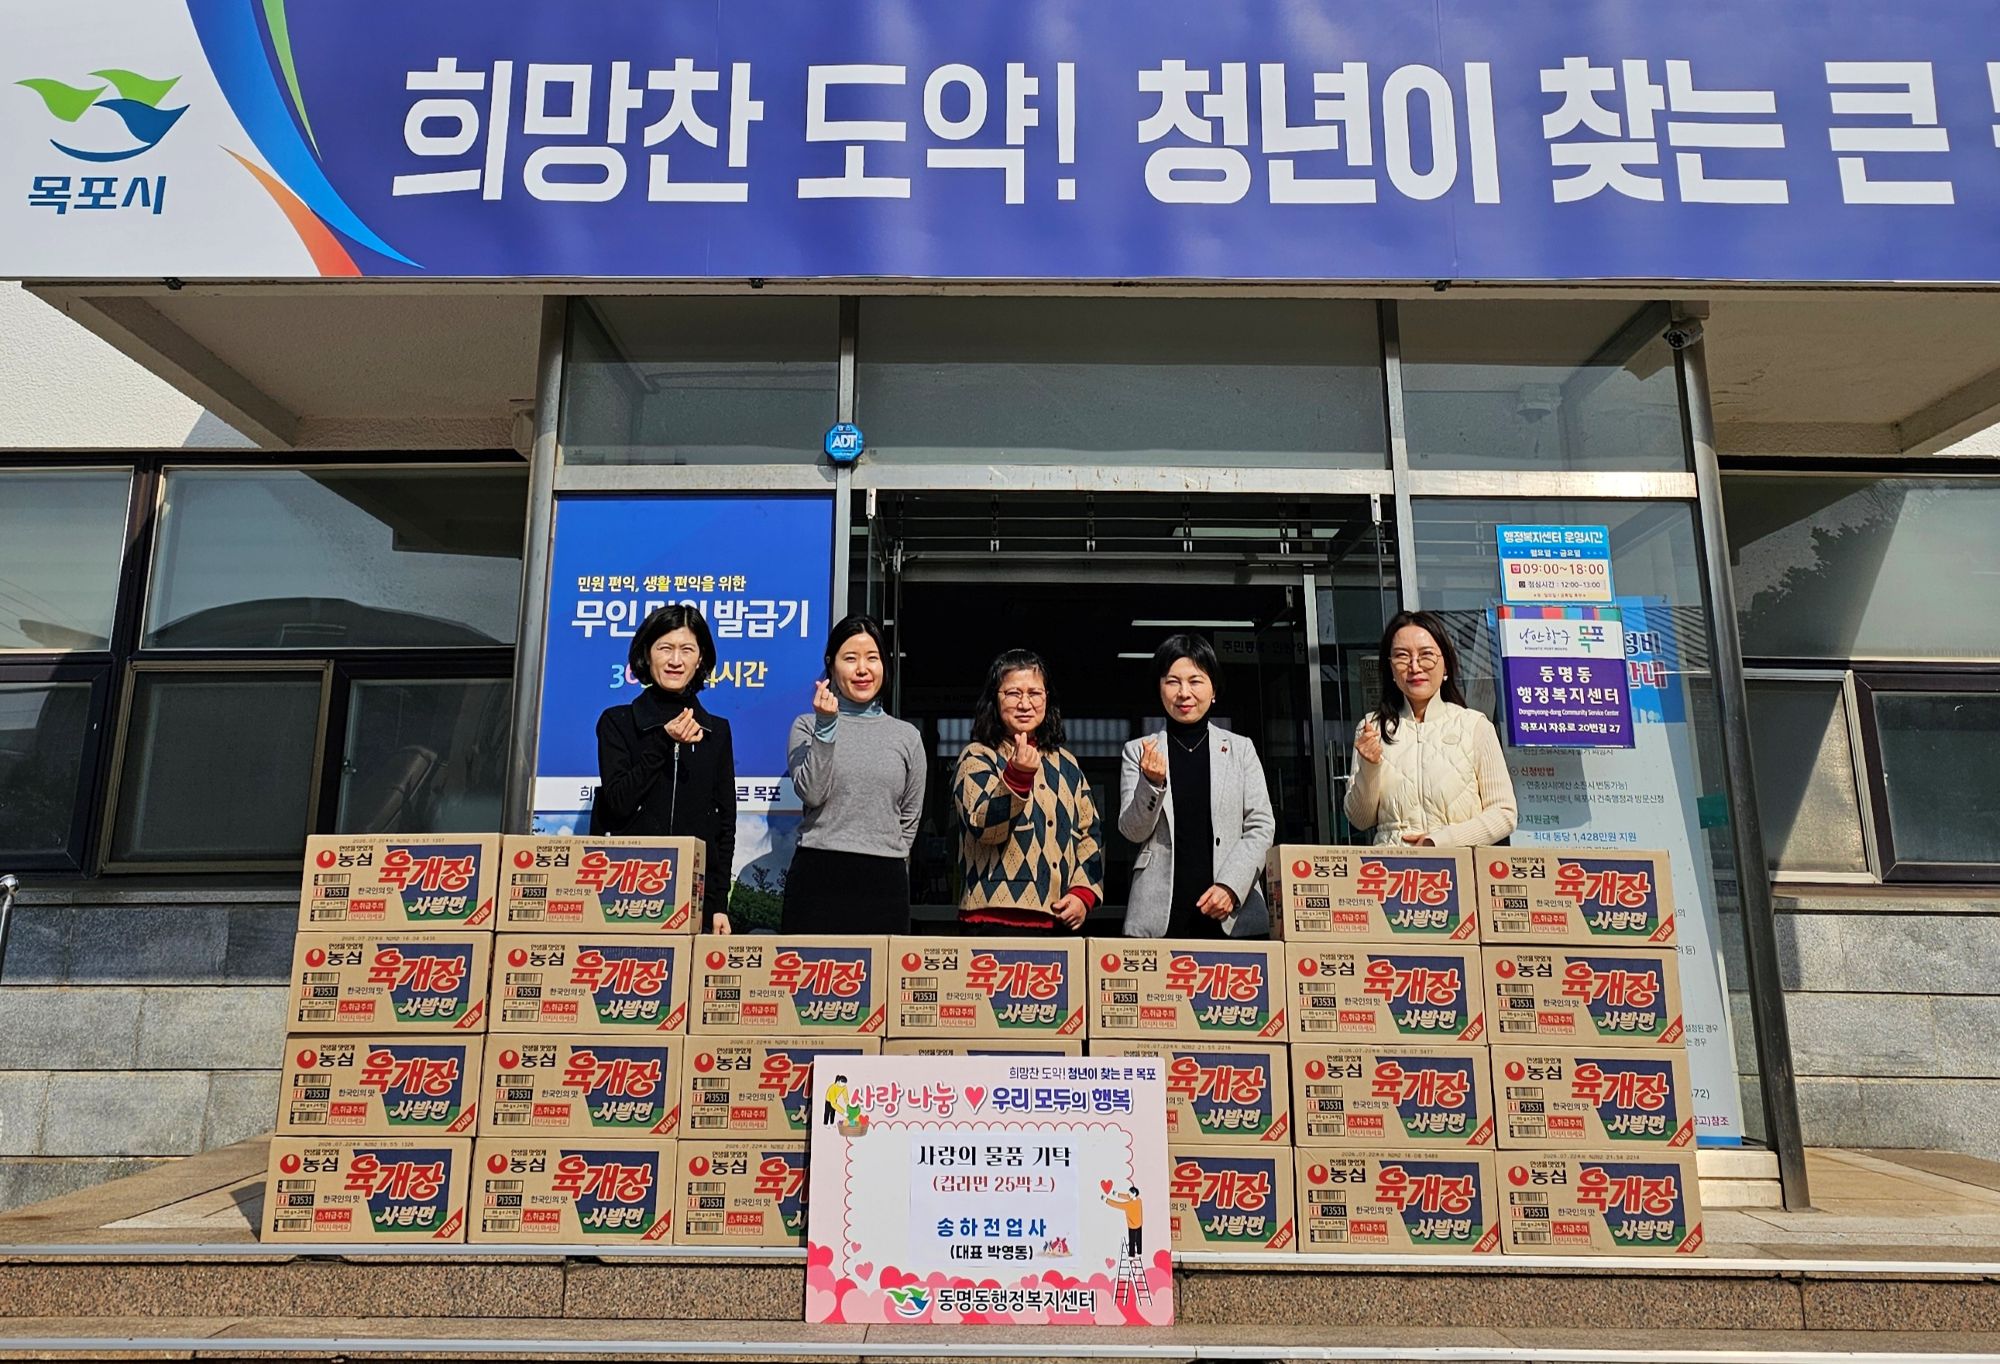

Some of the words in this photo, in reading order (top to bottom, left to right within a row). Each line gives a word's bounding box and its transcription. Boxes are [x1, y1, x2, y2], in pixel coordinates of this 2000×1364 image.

[392, 57, 764, 202] 희망찬
[797, 62, 1076, 204] 도약!
[1138, 60, 1500, 204] 청년이
[1540, 56, 1788, 204] 찾는
[1825, 62, 1955, 204] 큰
[28, 175, 168, 214] 목포시
[832, 434, 857, 449] ADT
[1504, 531, 1562, 544] 행정복지센터
[1565, 531, 1603, 545] 운영시간
[578, 576, 604, 593] 민원
[608, 576, 640, 593] 편익,
[643, 576, 671, 592] 생활
[674, 576, 715, 592] 편익을
[718, 576, 746, 592] 위한
[572, 600, 637, 638] 무인
[713, 600, 809, 638] 발급기
[1539, 666, 1592, 683] 동명동
[1517, 687, 1619, 704] 행정복지센터
[1520, 722, 1547, 733] 목포시
[1549, 722, 1576, 733] 자유로
[1609, 724, 1620, 733] 27
[754, 786, 781, 803] 목포
[1534, 832, 1551, 841] 최대
[1619, 832, 1637, 842] 지원
[338, 852, 372, 867] 농심
[535, 853, 570, 867] 농심
[1314, 863, 1348, 877] 농심
[378, 849, 475, 892] 육개장
[576, 853, 672, 894] 육개장
[1511, 864, 1545, 878] 농심
[1357, 862, 1450, 904] 육개장
[1555, 864, 1649, 906] 육개장
[408, 895, 467, 916] 사발면
[606, 899, 664, 918] 사발면
[1392, 909, 1448, 929] 사발면
[1591, 911, 1648, 931] 사발면
[327, 951, 362, 966] 농심
[529, 952, 564, 966] 농심
[727, 954, 762, 968] 농심
[923, 956, 958, 970] 농심
[1123, 957, 1157, 972] 농심
[1320, 962, 1354, 976] 농심
[368, 949, 466, 992] 육개장
[570, 952, 668, 994] 육개장
[769, 953, 866, 996] 육개장
[966, 955, 1062, 998] 육개장
[1166, 957, 1262, 1000] 육개장
[1518, 963, 1552, 978] 농심
[1364, 961, 1459, 1004] 육개장
[1562, 963, 1658, 1006] 육개장
[398, 997, 457, 1018] 사발면
[601, 999, 660, 1020] 사발면
[801, 1001, 859, 1021] 사발면
[999, 1003, 1057, 1024] 사발면
[1200, 1005, 1258, 1026] 사발면
[1399, 1009, 1456, 1030] 사발면
[1598, 1011, 1656, 1032] 사발면
[318, 1052, 354, 1067] 농심
[520, 1053, 556, 1068] 농심
[716, 1056, 751, 1071] 농심
[360, 1051, 459, 1095] 육개장
[562, 1052, 662, 1096] 육개장
[1010, 1067, 1039, 1080] 희망찬
[1042, 1068, 1065, 1080] 도약!
[1068, 1068, 1097, 1080] 청년이
[1101, 1068, 1120, 1080] 찾는
[1124, 1068, 1133, 1080] 큰
[1137, 1068, 1156, 1080] 목포
[1167, 1058, 1264, 1102] 육개장
[1327, 1063, 1362, 1078] 농심
[1527, 1065, 1562, 1080] 농심
[1372, 1063, 1468, 1107] 육개장
[1572, 1065, 1668, 1109] 육개장
[851, 1083, 901, 1115] 사랑
[907, 1083, 956, 1114] 나눔
[992, 1088, 1029, 1110] 우리
[1035, 1089, 1087, 1111] 모두의
[1092, 1088, 1132, 1112] 행복
[390, 1100, 450, 1121] 사발면
[594, 1101, 653, 1122] 사발면
[1202, 1108, 1261, 1129] 사발면
[1408, 1112, 1466, 1134] 사발면
[1608, 1114, 1666, 1135] 사발면
[302, 1157, 338, 1172] 농심
[509, 1157, 546, 1173] 농심
[917, 1146, 976, 1166] 사랑의
[985, 1146, 1023, 1166] 물품
[1033, 1146, 1071, 1166] 기탁
[344, 1154, 445, 1200] 육개장
[711, 1159, 747, 1175] 농심
[1330, 1168, 1366, 1183] 농심
[1531, 1169, 1567, 1185] 농심
[552, 1156, 652, 1202] 육개장
[995, 1176, 1055, 1192] 25박스)
[1170, 1163, 1269, 1209] 육개장
[1376, 1167, 1474, 1212] 육개장
[1577, 1168, 1676, 1214] 육개장
[376, 1205, 436, 1227] 사발면
[584, 1207, 644, 1229] 사발면
[1206, 1215, 1265, 1237] 사발면
[1412, 1218, 1471, 1240] 사발면
[1615, 1220, 1675, 1241] 사발면
[950, 1245, 982, 1260] (대표
[987, 1245, 1033, 1260] 박영동)
[938, 1290, 1096, 1312] 동명동행정복지센터
